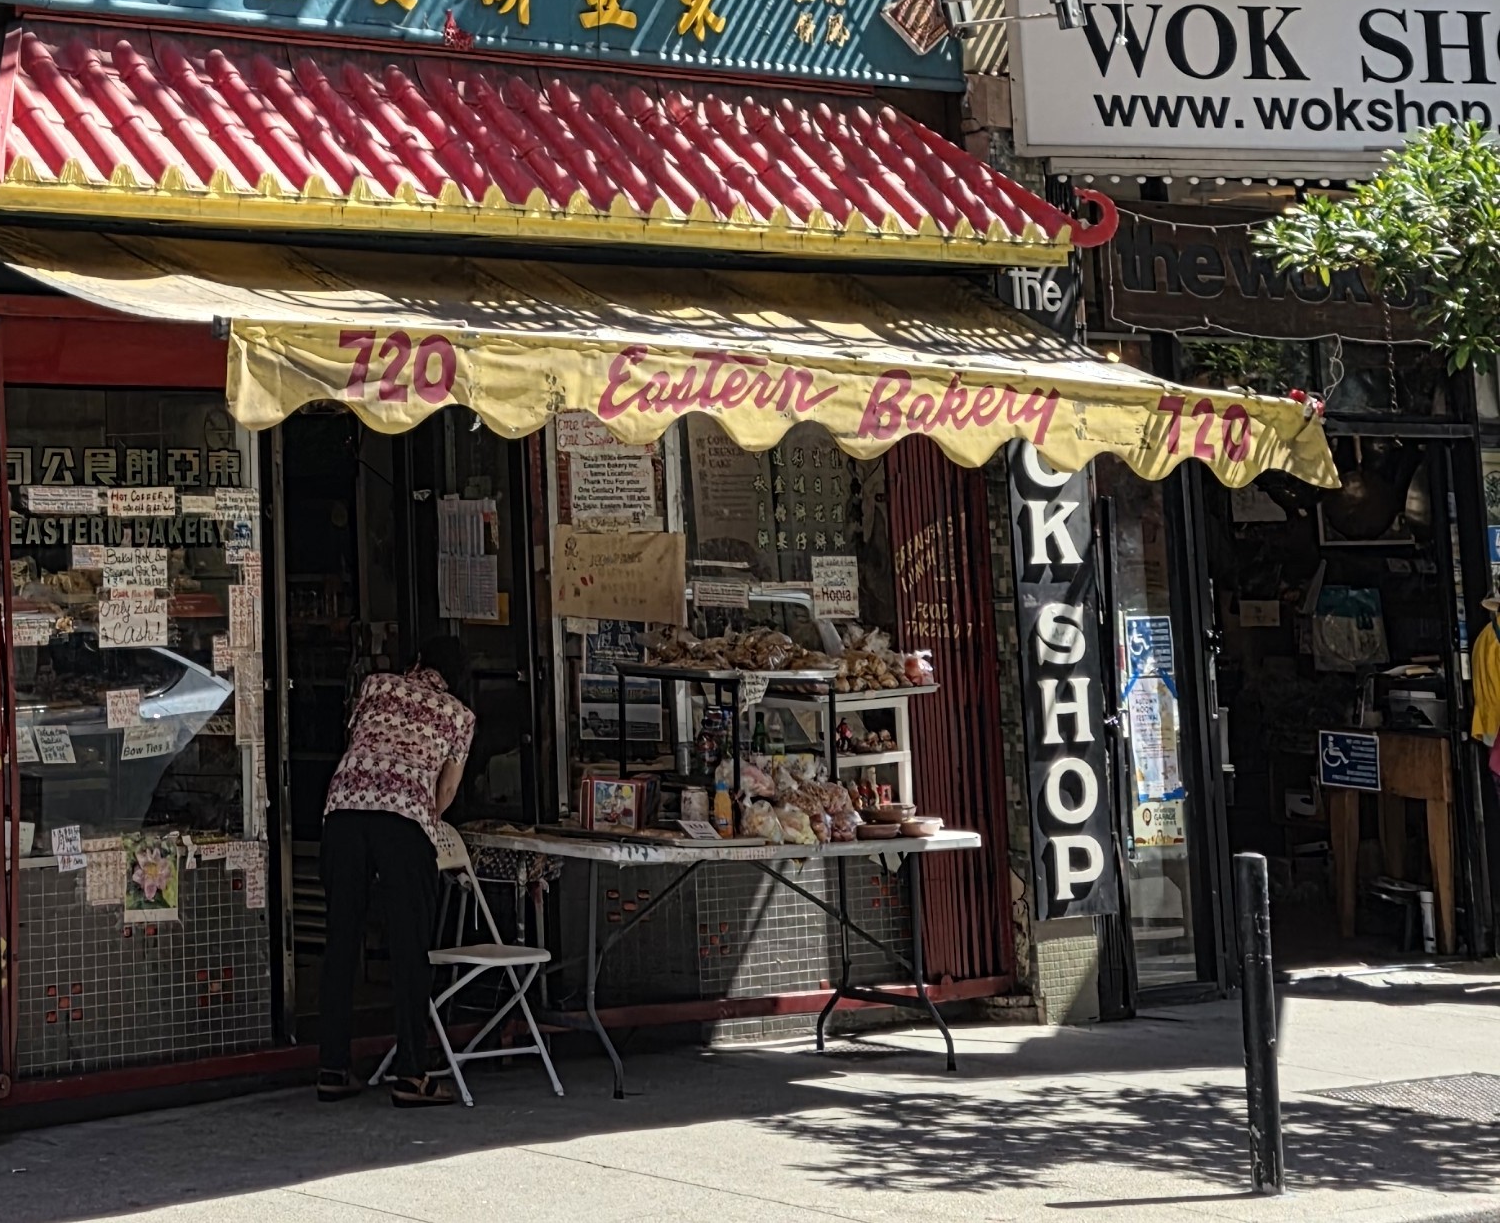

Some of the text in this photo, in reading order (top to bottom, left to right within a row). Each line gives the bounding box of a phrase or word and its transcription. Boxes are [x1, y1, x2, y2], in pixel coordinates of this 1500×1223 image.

[1082, 3, 1500, 85] WOK SH
[1007, 267, 1063, 312] the
[339, 330, 457, 405] 720
[599, 344, 1062, 446] Eastern Bakery
[1157, 395, 1252, 463] 720
[111, 490, 127, 502] HOT
[131, 490, 163, 502] COFFEE
[10, 517, 228, 545] EASTERN BAKERY
[100, 600, 131, 623] Only
[821, 586, 852, 606] Hopia
[113, 619, 161, 645] Cash!
[124, 744, 143, 757] Bow
[1036, 602, 1105, 900] SHOP
